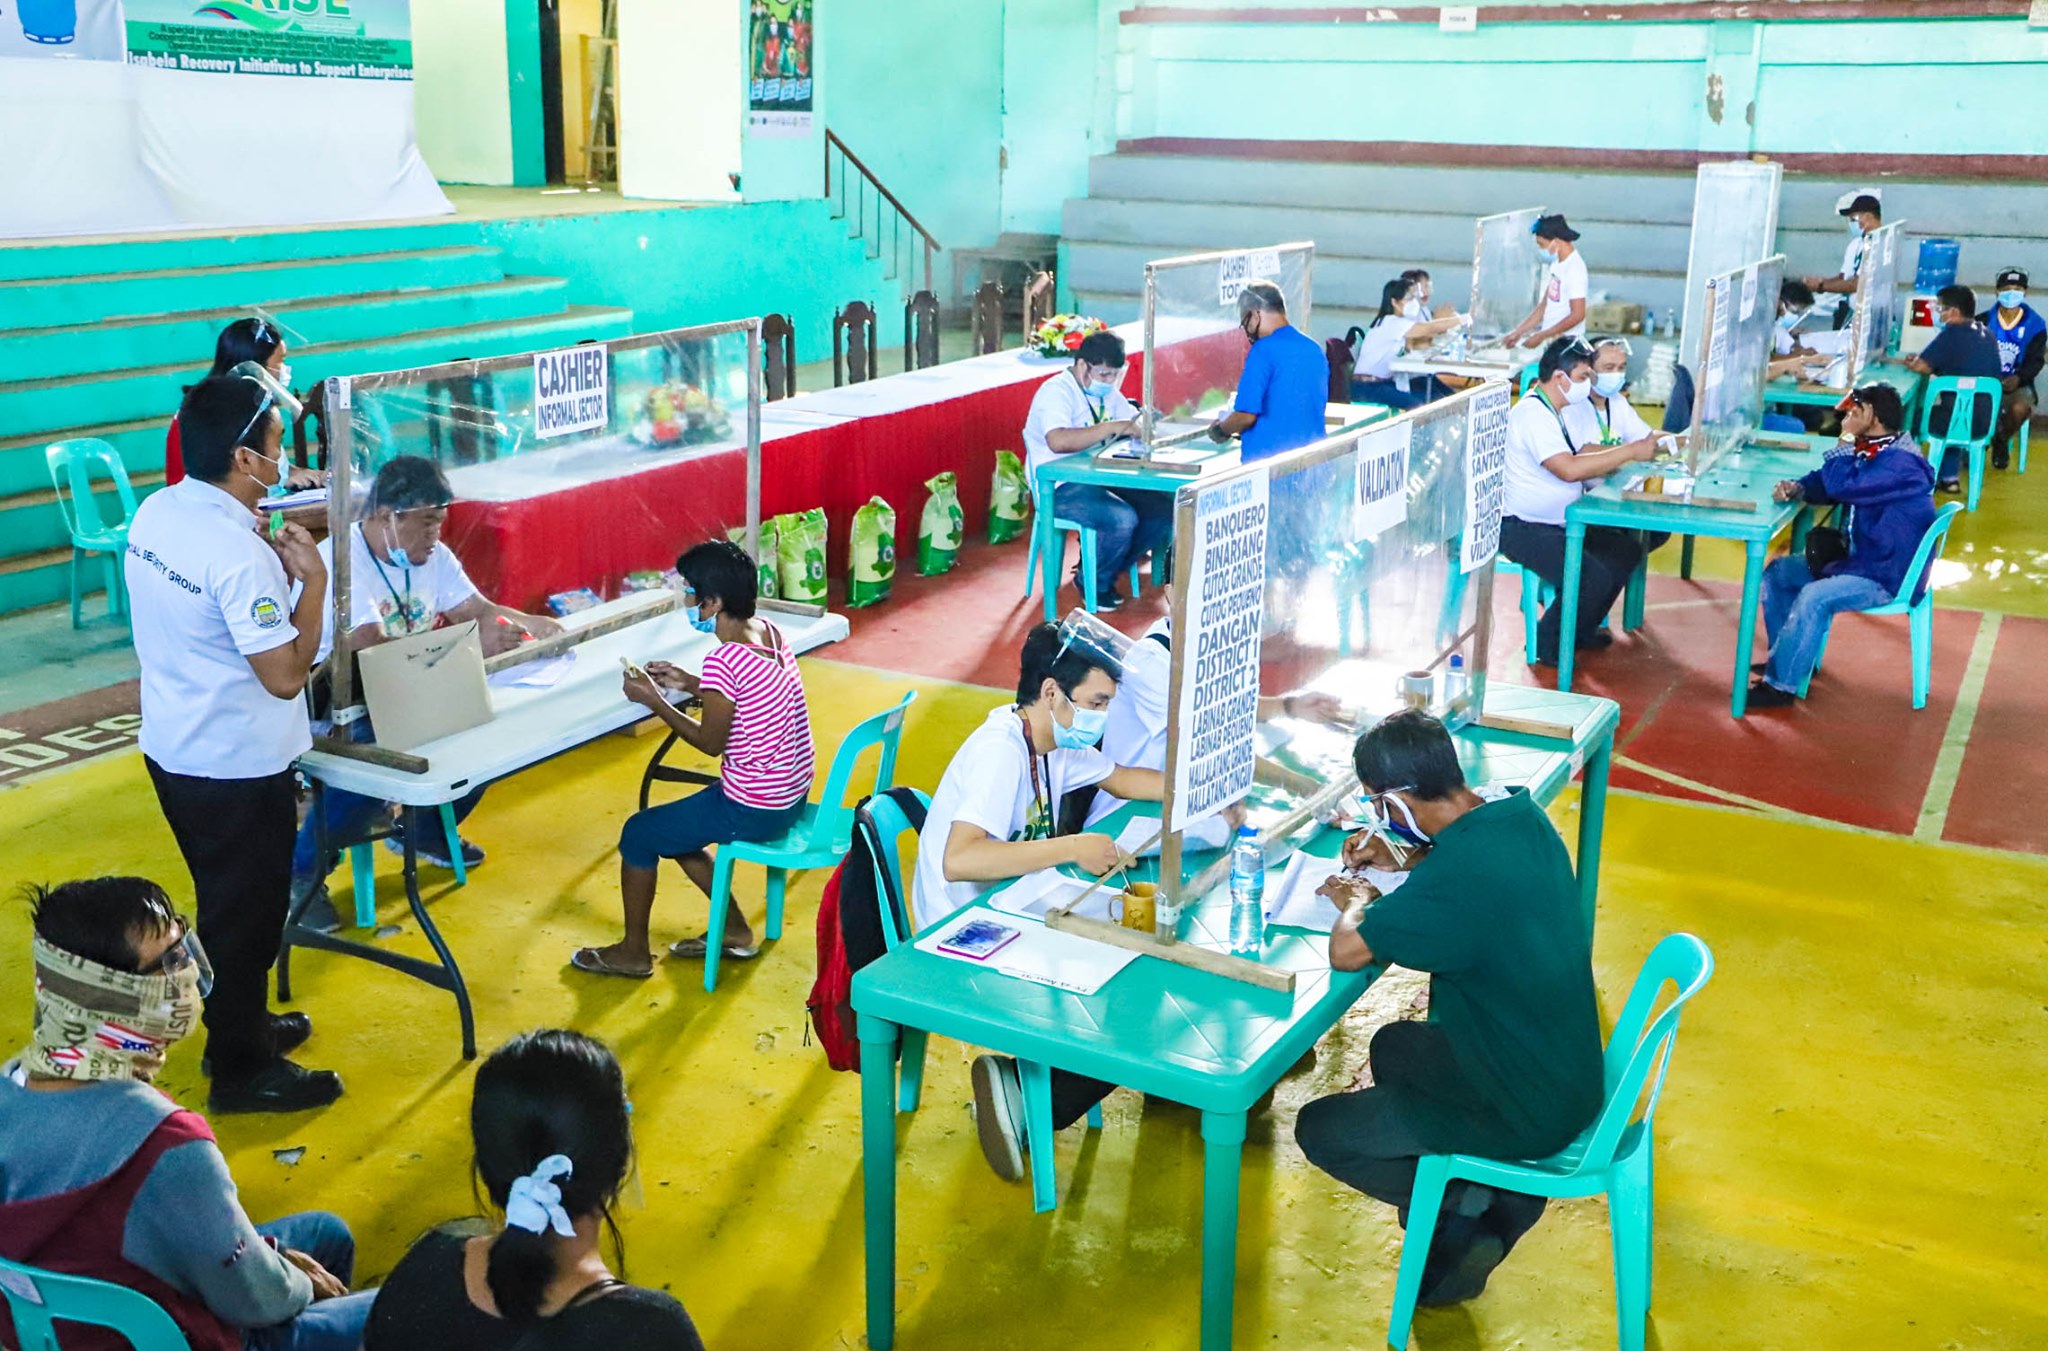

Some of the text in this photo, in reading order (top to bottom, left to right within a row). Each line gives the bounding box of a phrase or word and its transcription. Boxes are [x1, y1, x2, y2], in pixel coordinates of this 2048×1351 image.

[128, 51, 177, 68] Isabela
[180, 53, 236, 73] Recovery
[239, 57, 297, 74] Initiatives
[300, 60, 312, 74] to
[314, 61, 356, 78] Support
[538, 349, 603, 398] CASHIER
[538, 394, 604, 430] INFORMAL SECTOR
[1198, 480, 1252, 517] INFORMAL SECTOR
[1360, 447, 1405, 506] VALIDATION
[1205, 503, 1266, 545] BANQUERO
[1204, 529, 1264, 575] BINARSANG
[168, 570, 202, 596] GROUP
[1202, 555, 1263, 602] CUTOG GRANDE
[1198, 609, 1261, 659] DANGAN
[1200, 597, 1227, 629] CUTOG
[1195, 637, 1258, 685] DISTRICT 1
[1193, 664, 1257, 712] DISTRICT 2
[1192, 687, 1256, 739] LABINAB GRANDE
[1190, 727, 1222, 762] LABINAB
[1231, 738, 1253, 770] GRANDE
